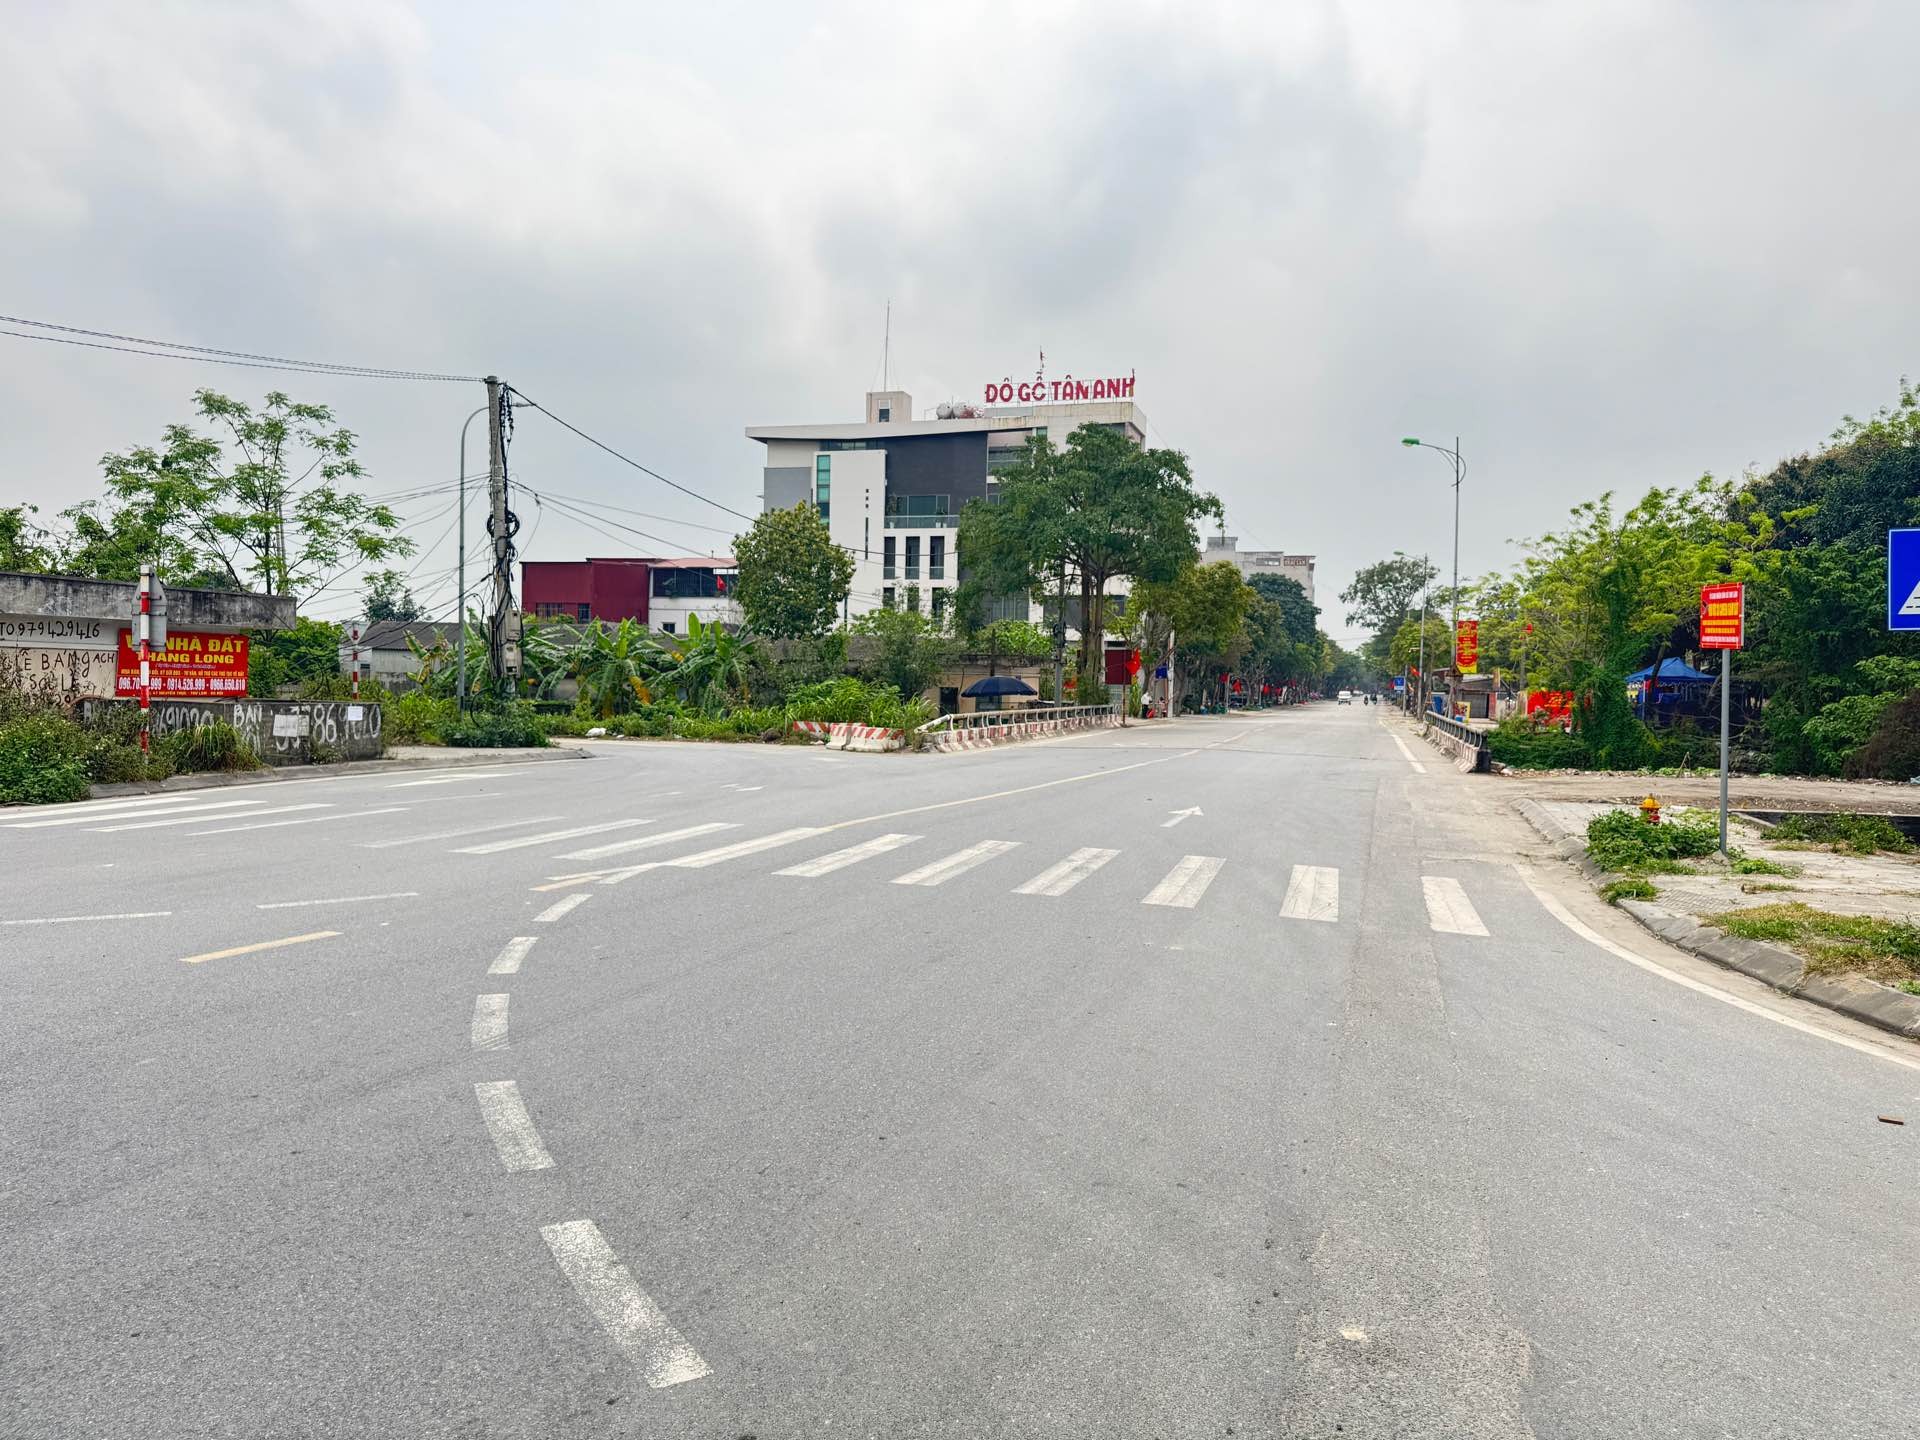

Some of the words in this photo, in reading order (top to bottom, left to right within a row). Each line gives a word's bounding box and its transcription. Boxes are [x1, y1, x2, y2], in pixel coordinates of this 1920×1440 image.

[1051, 375, 1089, 401] TÂN
[1093, 377, 1136, 400] ANH
[195, 653, 234, 664] LONG
